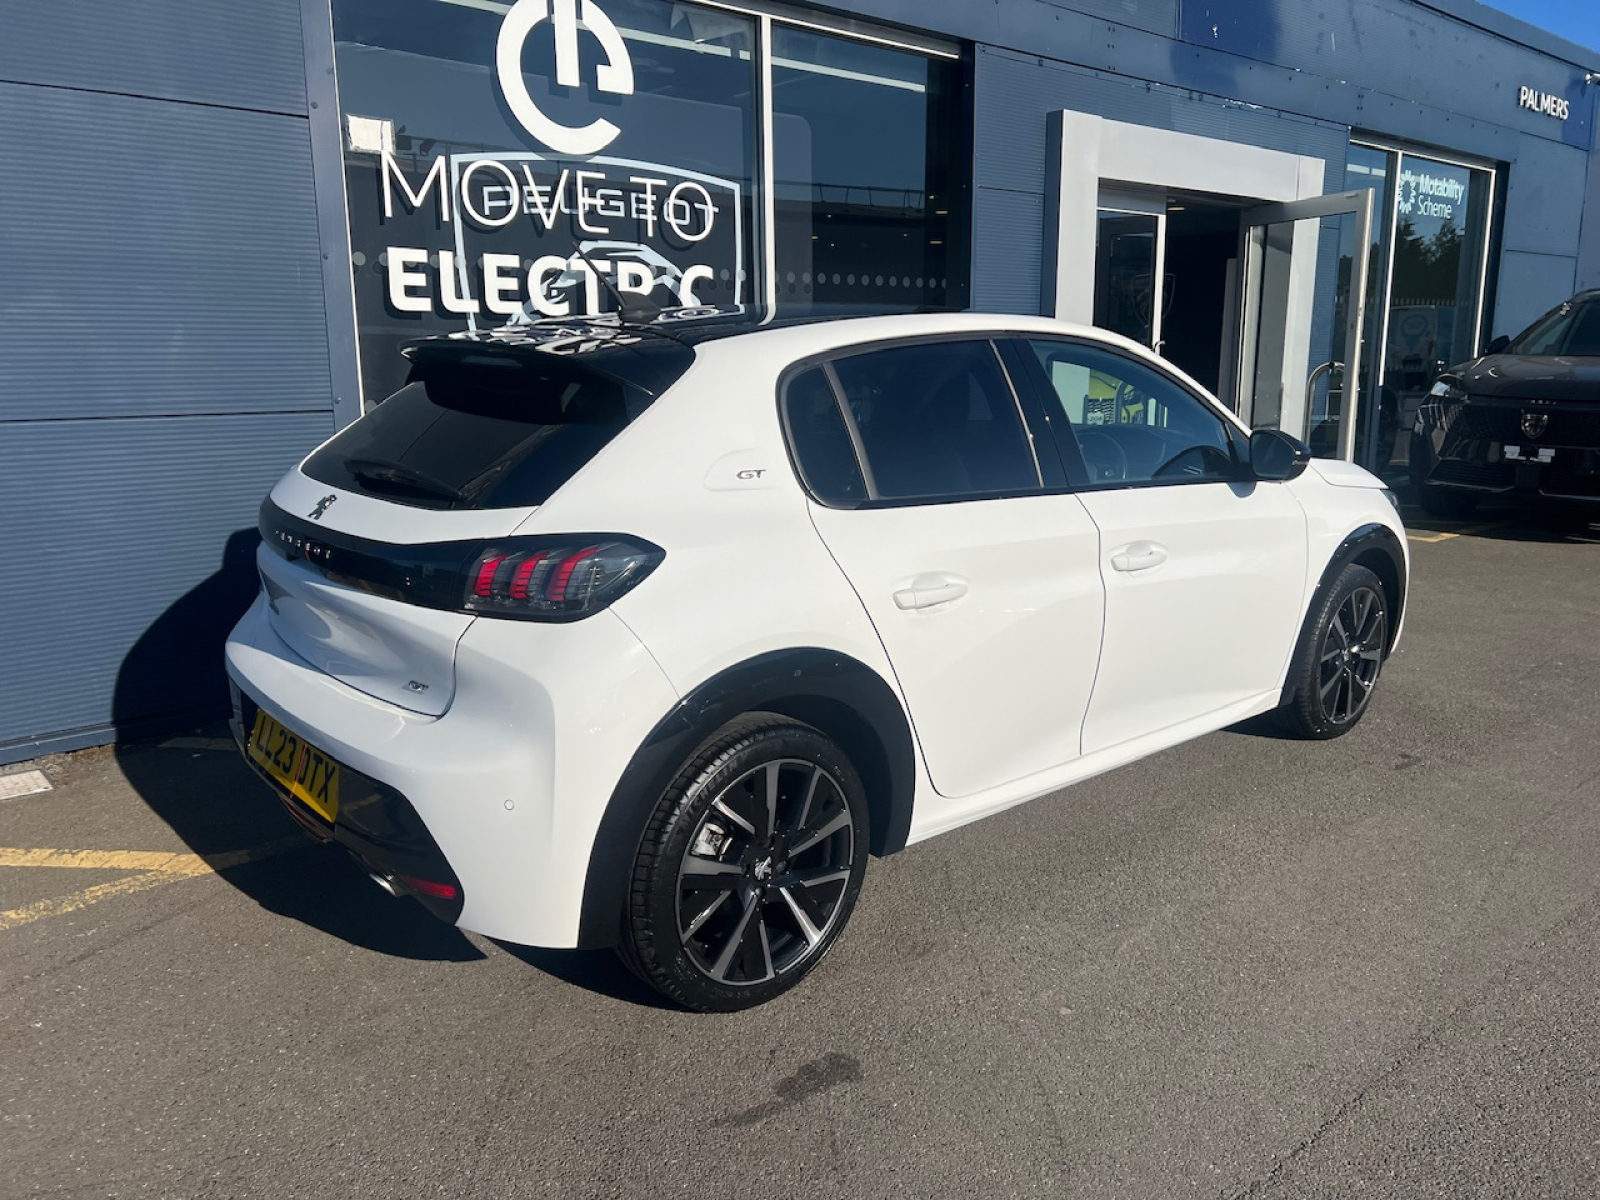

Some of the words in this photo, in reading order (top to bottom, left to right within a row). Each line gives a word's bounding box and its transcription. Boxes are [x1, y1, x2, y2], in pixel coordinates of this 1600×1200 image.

[1520, 85, 1570, 120] PALMERS
[381, 150, 610, 234] MOVE
[630, 176, 715, 242] TO
[483, 185, 719, 229] PEUGEOT
[1417, 195, 1452, 219] Scheme
[1419, 173, 1465, 206] Motability
[736, 468, 767, 480] GT
[256, 713, 297, 775] LL23
[295, 743, 336, 805] DTX
